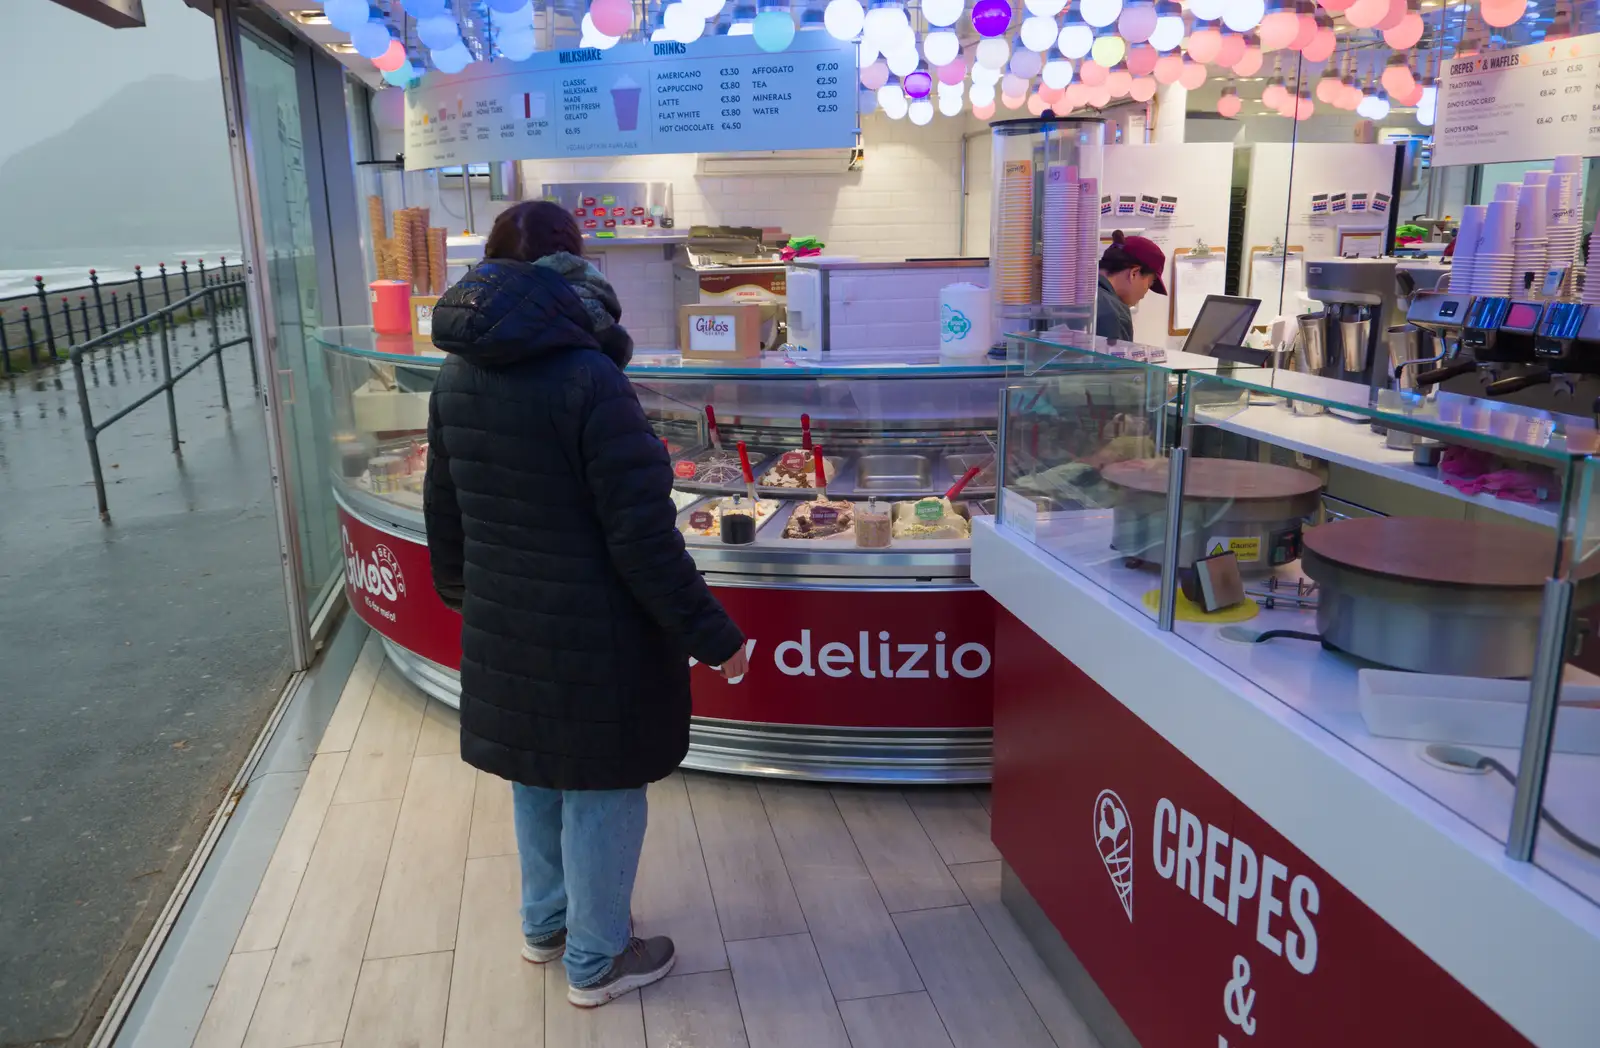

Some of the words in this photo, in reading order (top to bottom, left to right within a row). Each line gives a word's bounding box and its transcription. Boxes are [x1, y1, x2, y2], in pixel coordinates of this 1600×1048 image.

[654, 42, 687, 55] DRINKS
[559, 49, 602, 63] MILKSHAKE
[752, 65, 794, 75] AFFOGATO
[816, 63, 839, 71] €7.00
[1450, 61, 1474, 75] CREPES
[1482, 59, 1488, 70] &
[1490, 54, 1519, 68] WAFFLES
[657, 70, 701, 80] AMERICANO
[720, 68, 739, 76] €3.30
[562, 79, 587, 87] CLASSIC
[657, 84, 703, 93] CAPPUCCINO
[720, 82, 740, 90] €3.80
[752, 81, 767, 89] TEA
[816, 77, 837, 85] €2.50
[1449, 81, 1482, 90] TRADITIONAL
[563, 86, 597, 94] MILKSHAKE
[658, 98, 680, 107] LATTE
[721, 95, 741, 103] €3.80
[752, 93, 792, 102] MINERALS
[816, 91, 837, 99] €2.50
[1447, 100, 1464, 108] GINO'S
[1465, 98, 1479, 106] CHOC
[1480, 96, 1496, 105] OREO
[581, 102, 600, 110] FRESH
[753, 107, 779, 115] WATER
[817, 104, 838, 112] €2.50
[564, 112, 588, 120] GELATO
[677, 110, 700, 118] WHITE
[721, 108, 741, 117] €3.80
[565, 127, 580, 135] €6.95
[660, 125, 673, 133] HOT
[674, 123, 714, 132] CHOCOLATE
[721, 121, 741, 130] €4.50
[696, 317, 729, 333] Gino's
[342, 524, 397, 601] Gino's
[377, 546, 404, 593] GELATO
[774, 629, 992, 679] delizio
[1153, 797, 1320, 975] CREPES
[1223, 954, 1257, 1036] &
